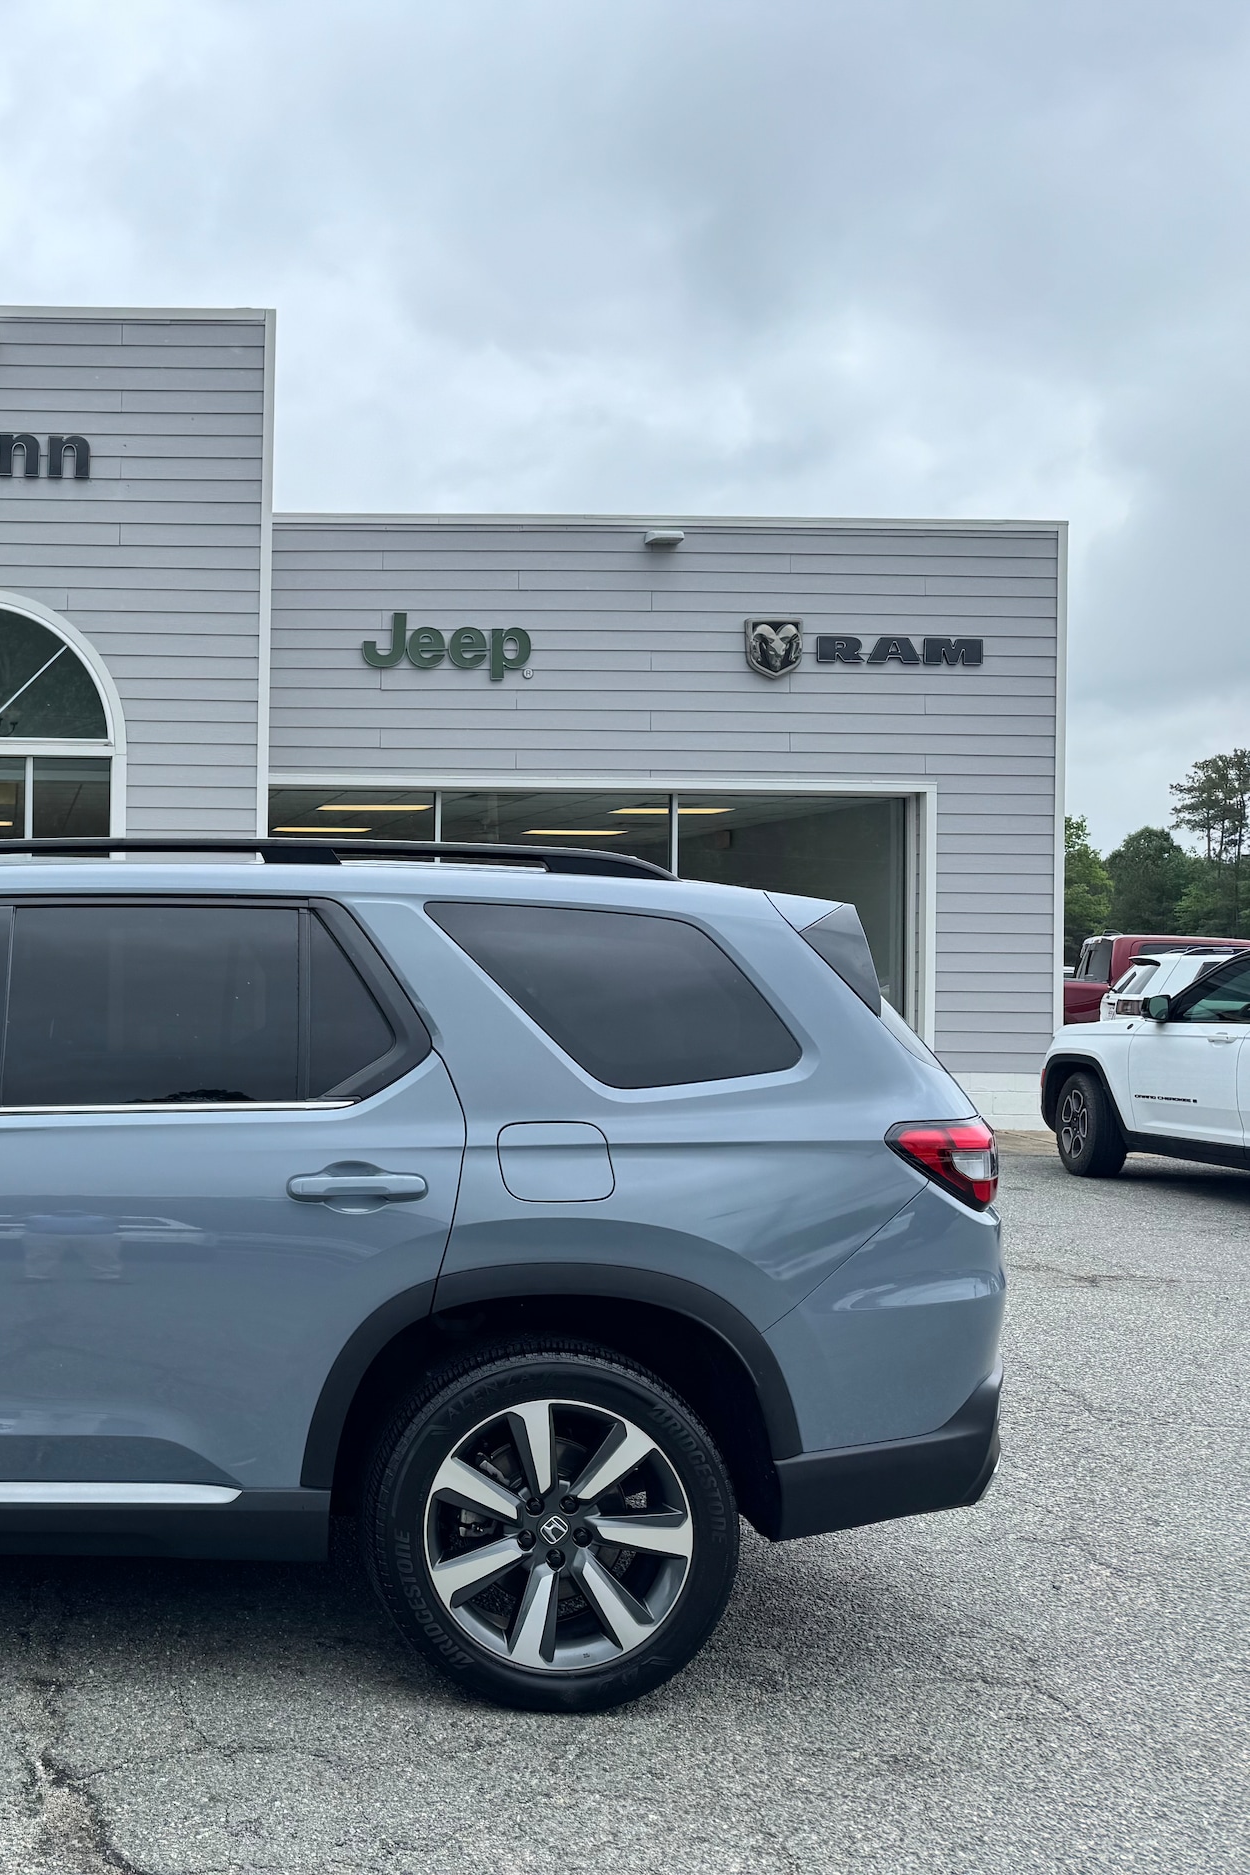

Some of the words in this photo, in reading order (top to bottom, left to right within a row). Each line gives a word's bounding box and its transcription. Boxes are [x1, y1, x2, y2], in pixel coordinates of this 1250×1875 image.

[362, 612, 532, 681] Jeep
[817, 636, 984, 666] RAM
[650, 1404, 728, 1545] BRIDGESTONE
[394, 1526, 476, 1670] BRIDGESTONE
